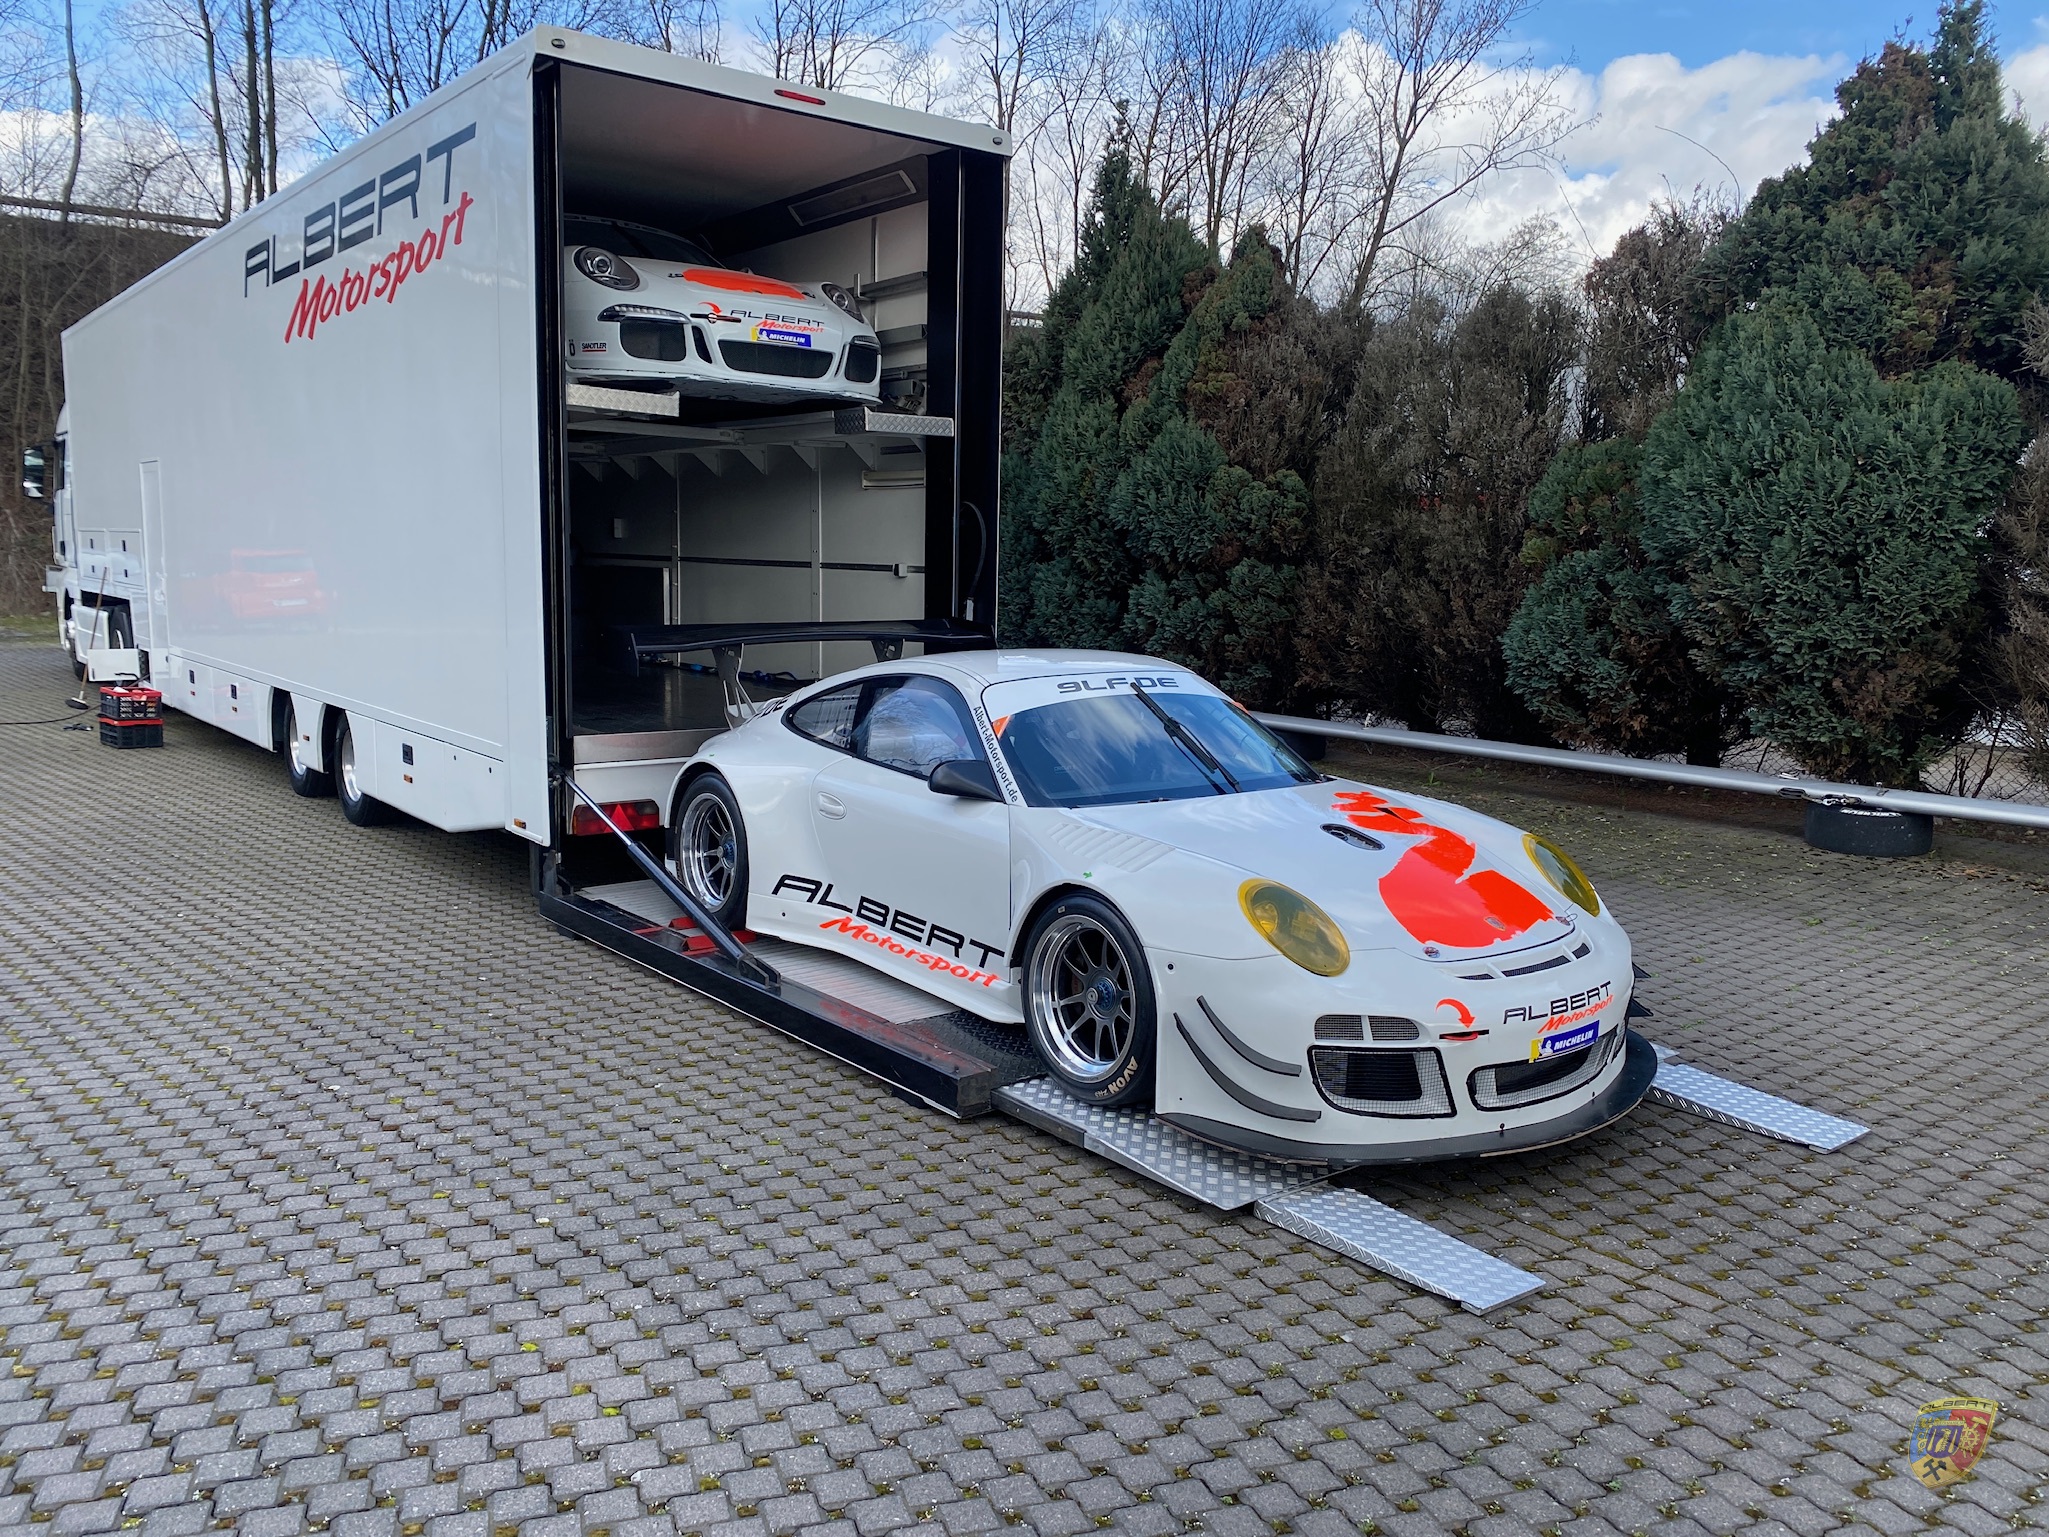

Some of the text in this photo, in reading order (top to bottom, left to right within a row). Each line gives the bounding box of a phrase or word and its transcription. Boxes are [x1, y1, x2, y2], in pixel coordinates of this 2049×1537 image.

[244, 121, 477, 298] ALBERT
[284, 191, 474, 344] Motorsport
[730, 309, 825, 328] ALBERT
[755, 319, 825, 334] Motorsport
[768, 332, 806, 344] MICHELIN
[771, 874, 1006, 969] ALBERT
[819, 916, 1003, 987] Motorsport
[1503, 980, 1611, 1024] ALBERT
[1537, 994, 1614, 1034] Motorsport
[1554, 1030, 1594, 1050] MICHELIN
[1107, 1055, 1139, 1094] AVON
